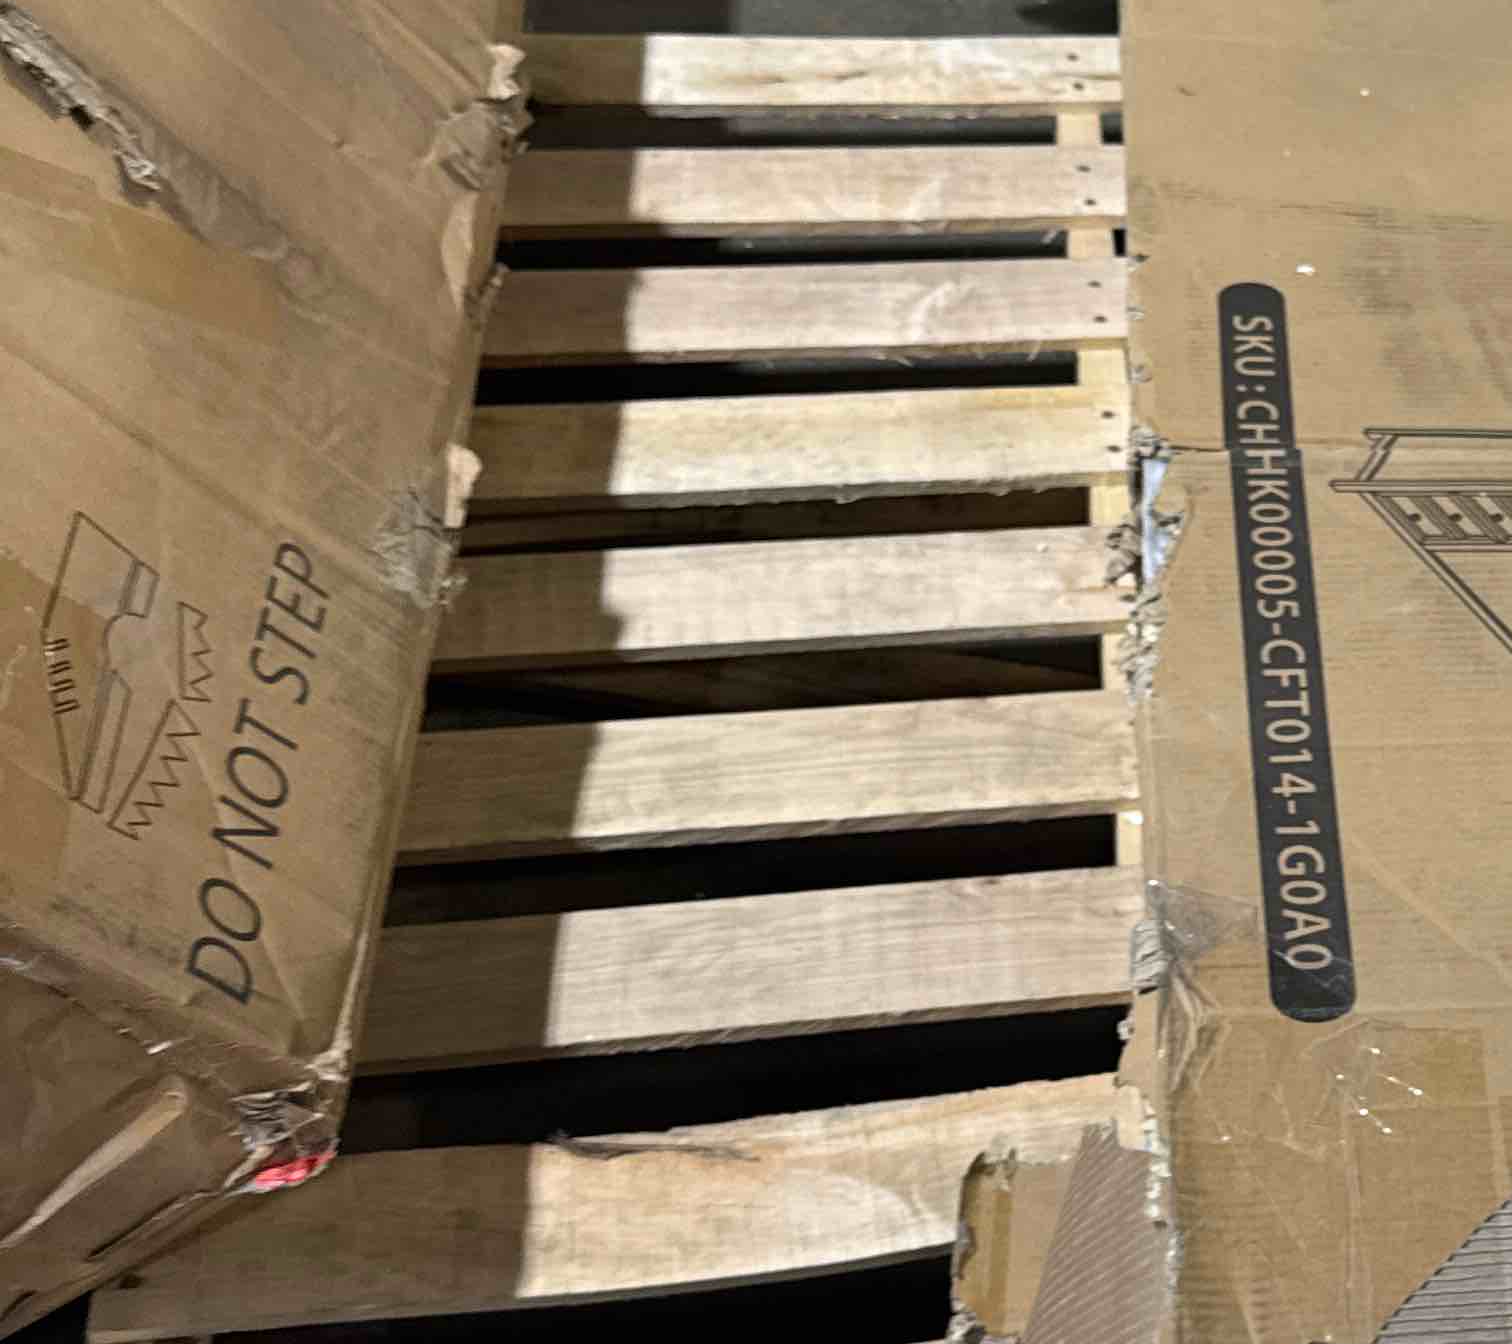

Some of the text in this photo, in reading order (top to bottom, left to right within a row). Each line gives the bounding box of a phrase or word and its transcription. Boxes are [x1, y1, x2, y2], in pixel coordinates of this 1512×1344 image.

[186, 540, 333, 1006] DO NOT STEP
